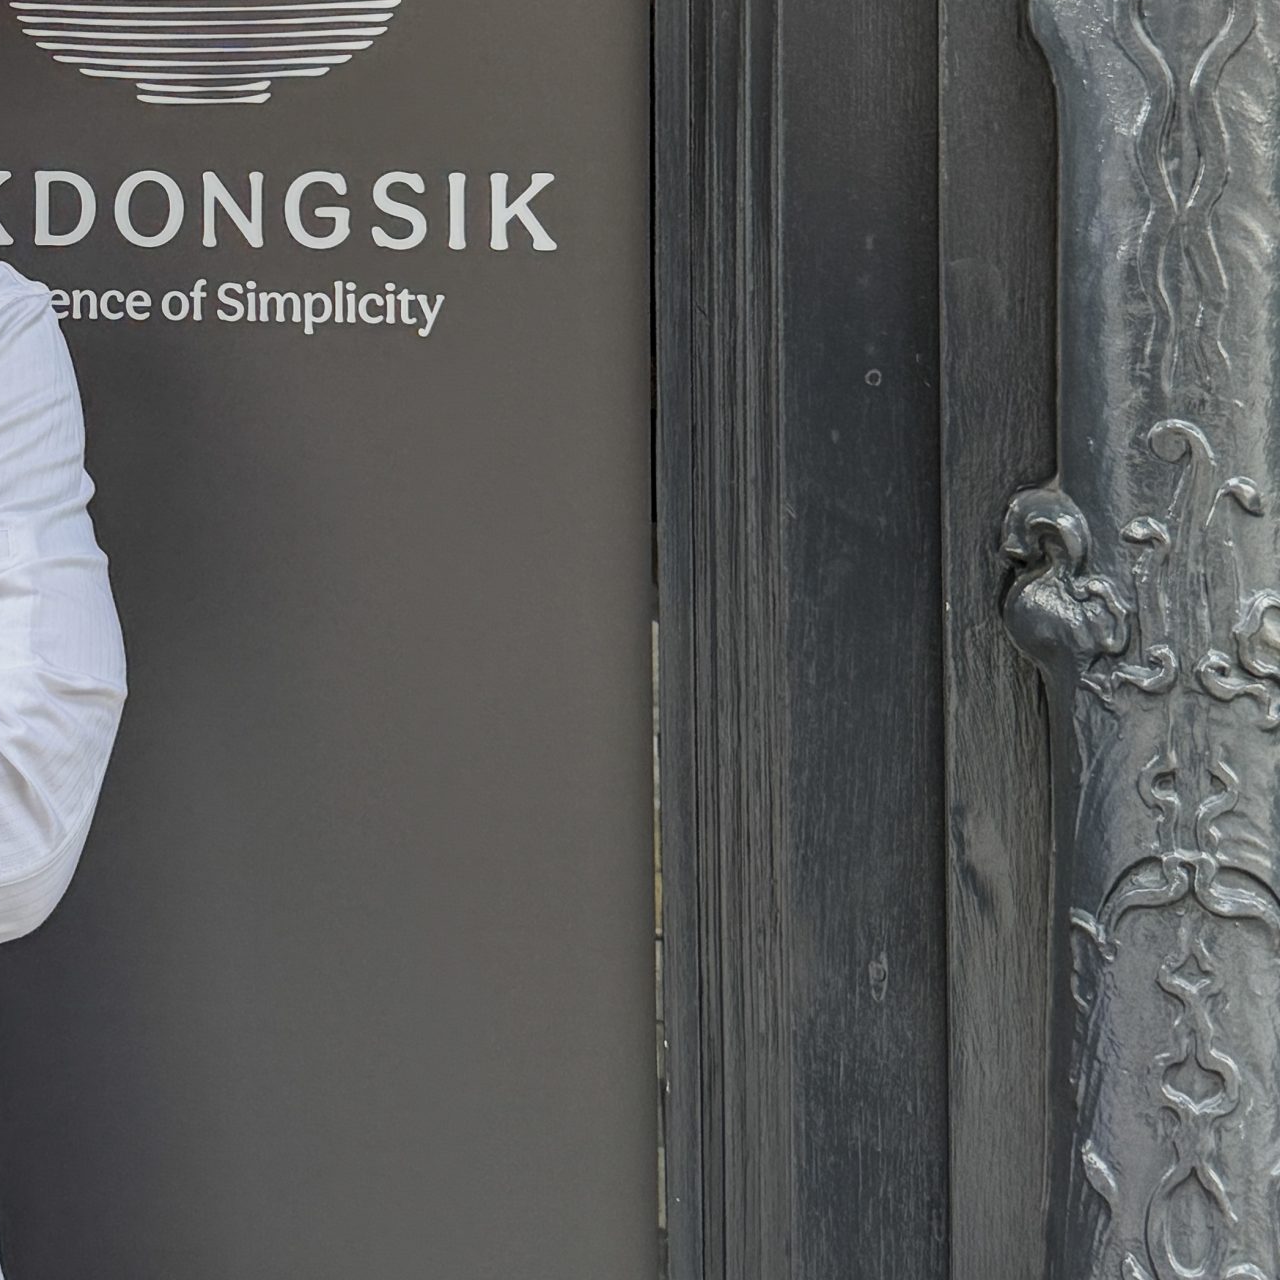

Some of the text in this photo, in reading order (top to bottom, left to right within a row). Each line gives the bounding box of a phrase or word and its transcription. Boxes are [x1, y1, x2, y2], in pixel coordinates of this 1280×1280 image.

[51, 278, 445, 337] ence of Simplicity
